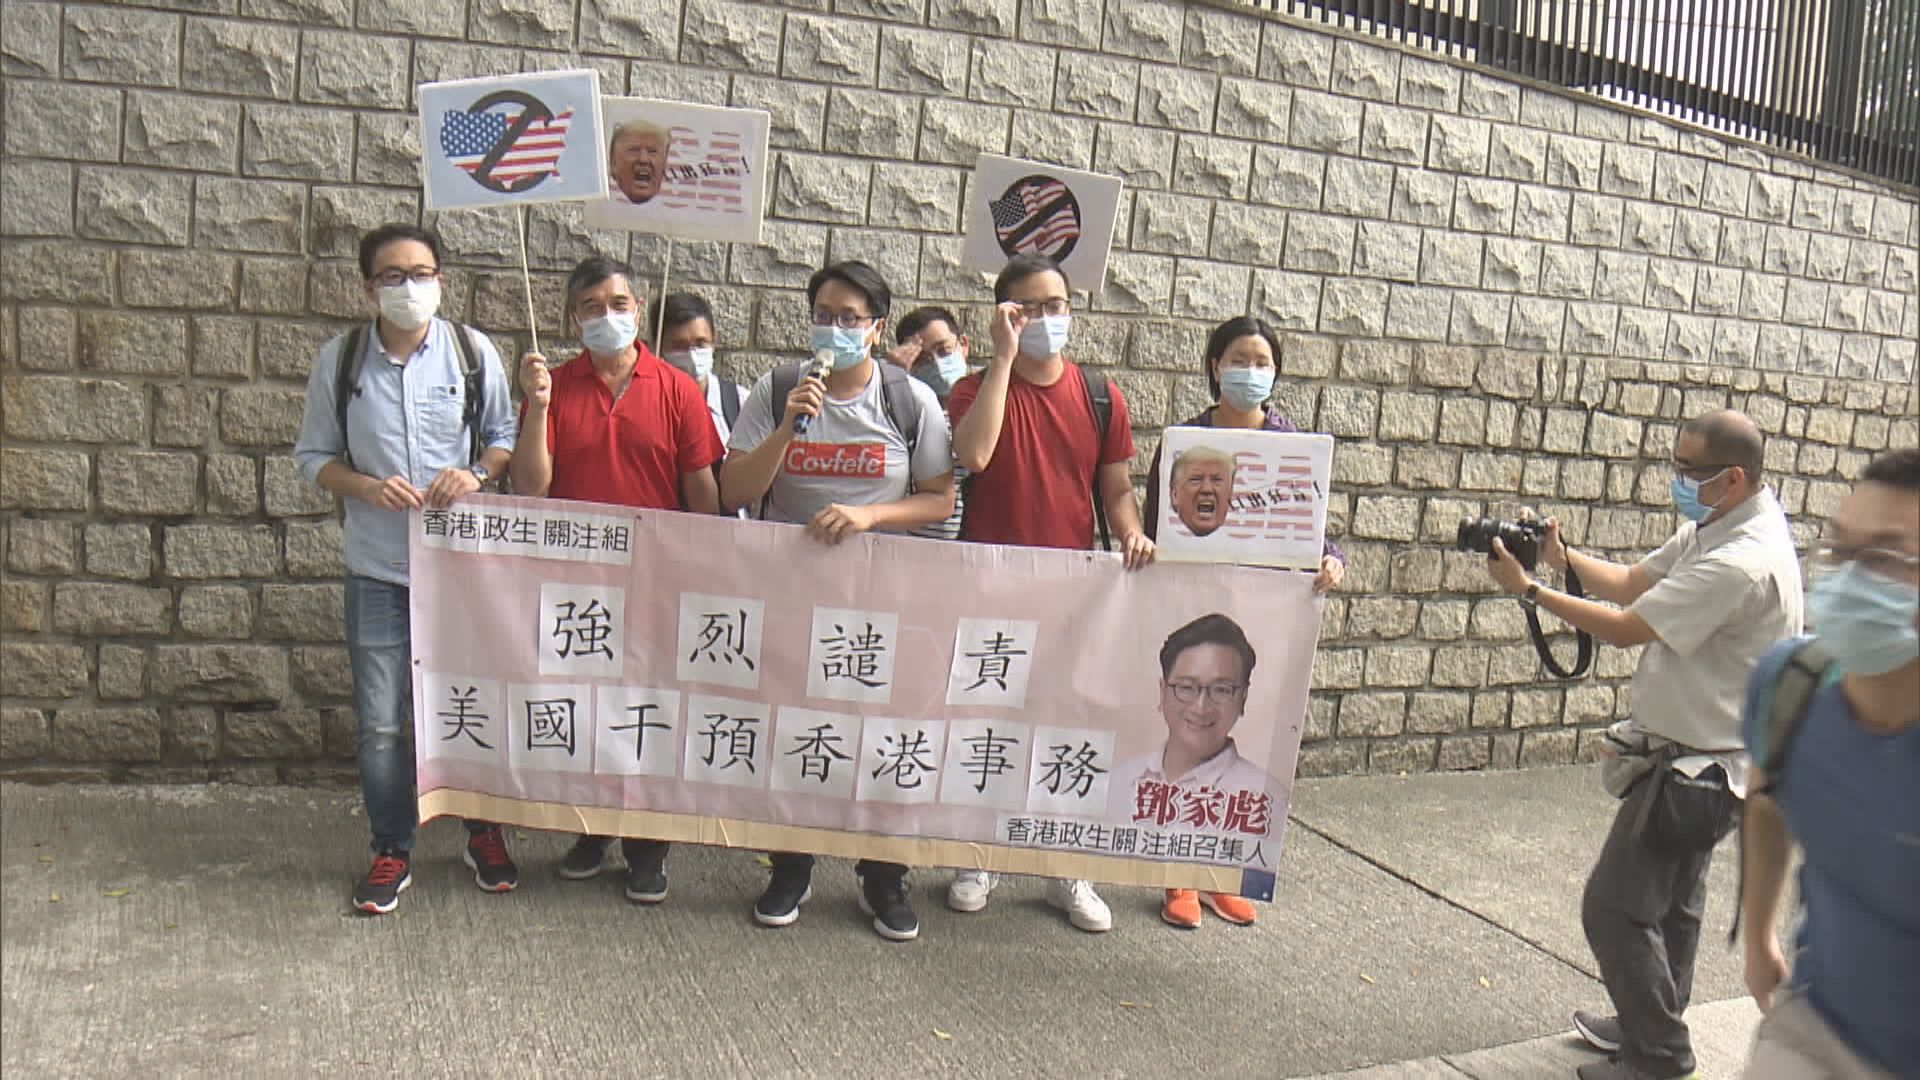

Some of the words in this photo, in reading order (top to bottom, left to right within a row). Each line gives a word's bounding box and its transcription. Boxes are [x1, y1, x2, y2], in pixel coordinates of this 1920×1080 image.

[551, 599, 1027, 692] 強烈譴責
[437, 687, 1109, 798] 美國干預香港事務
[1132, 780, 1271, 835] 鄧家彪
